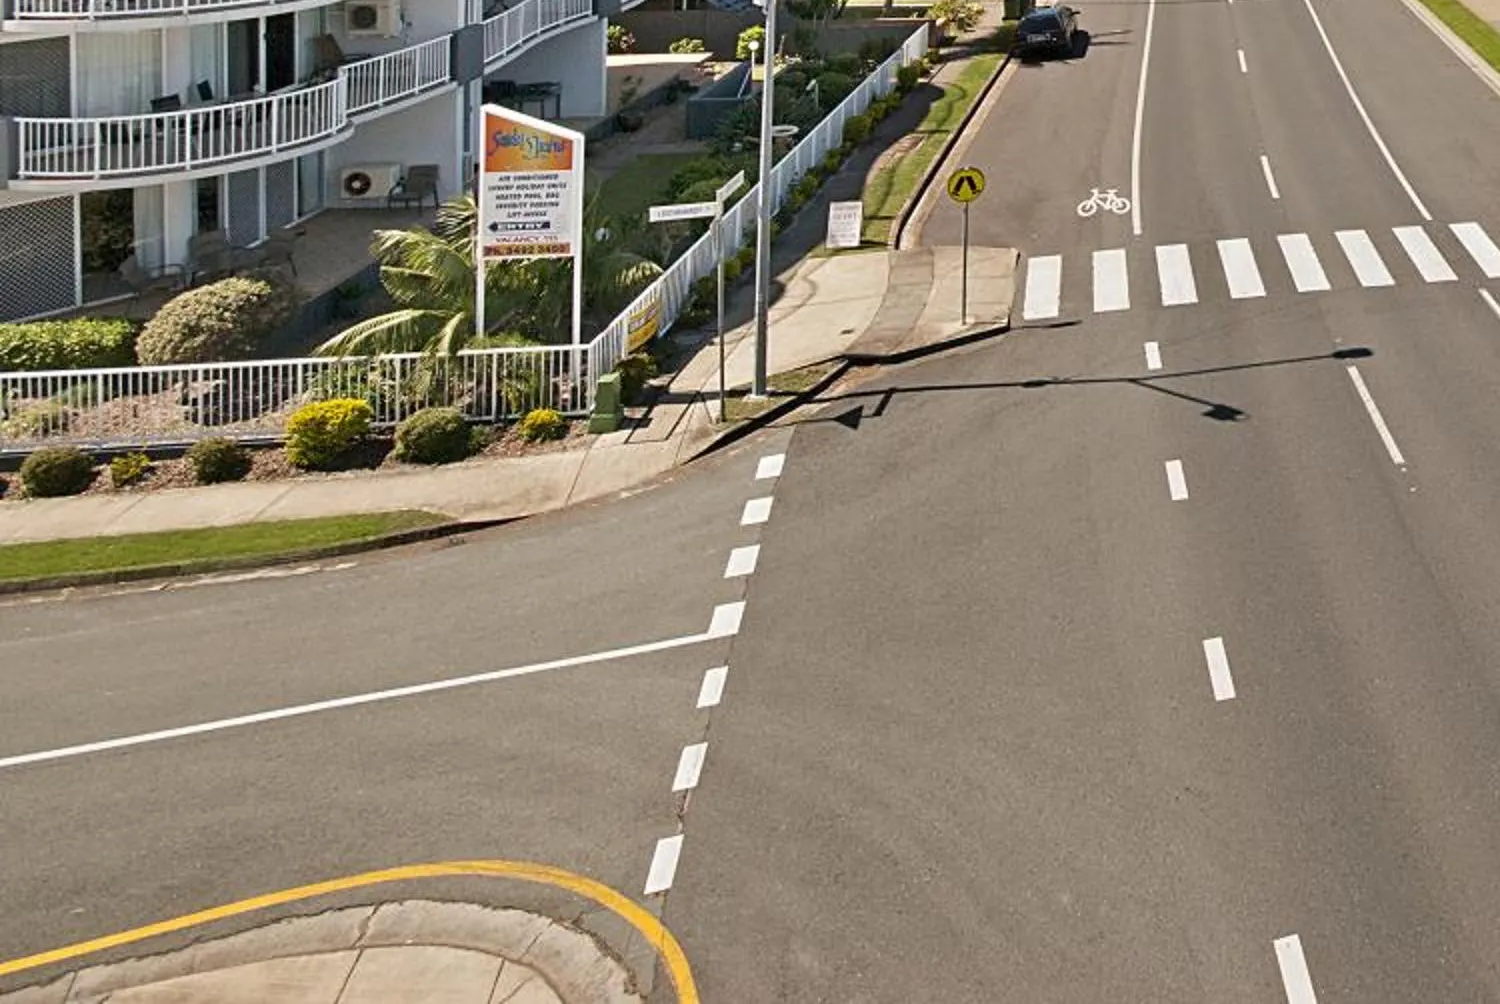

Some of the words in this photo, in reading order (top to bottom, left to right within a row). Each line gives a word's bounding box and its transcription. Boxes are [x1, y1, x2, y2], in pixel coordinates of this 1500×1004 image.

[516, 183, 545, 191] HOLIDAY
[495, 192, 522, 200] HEATED
[497, 222, 543, 231] ENTRY
